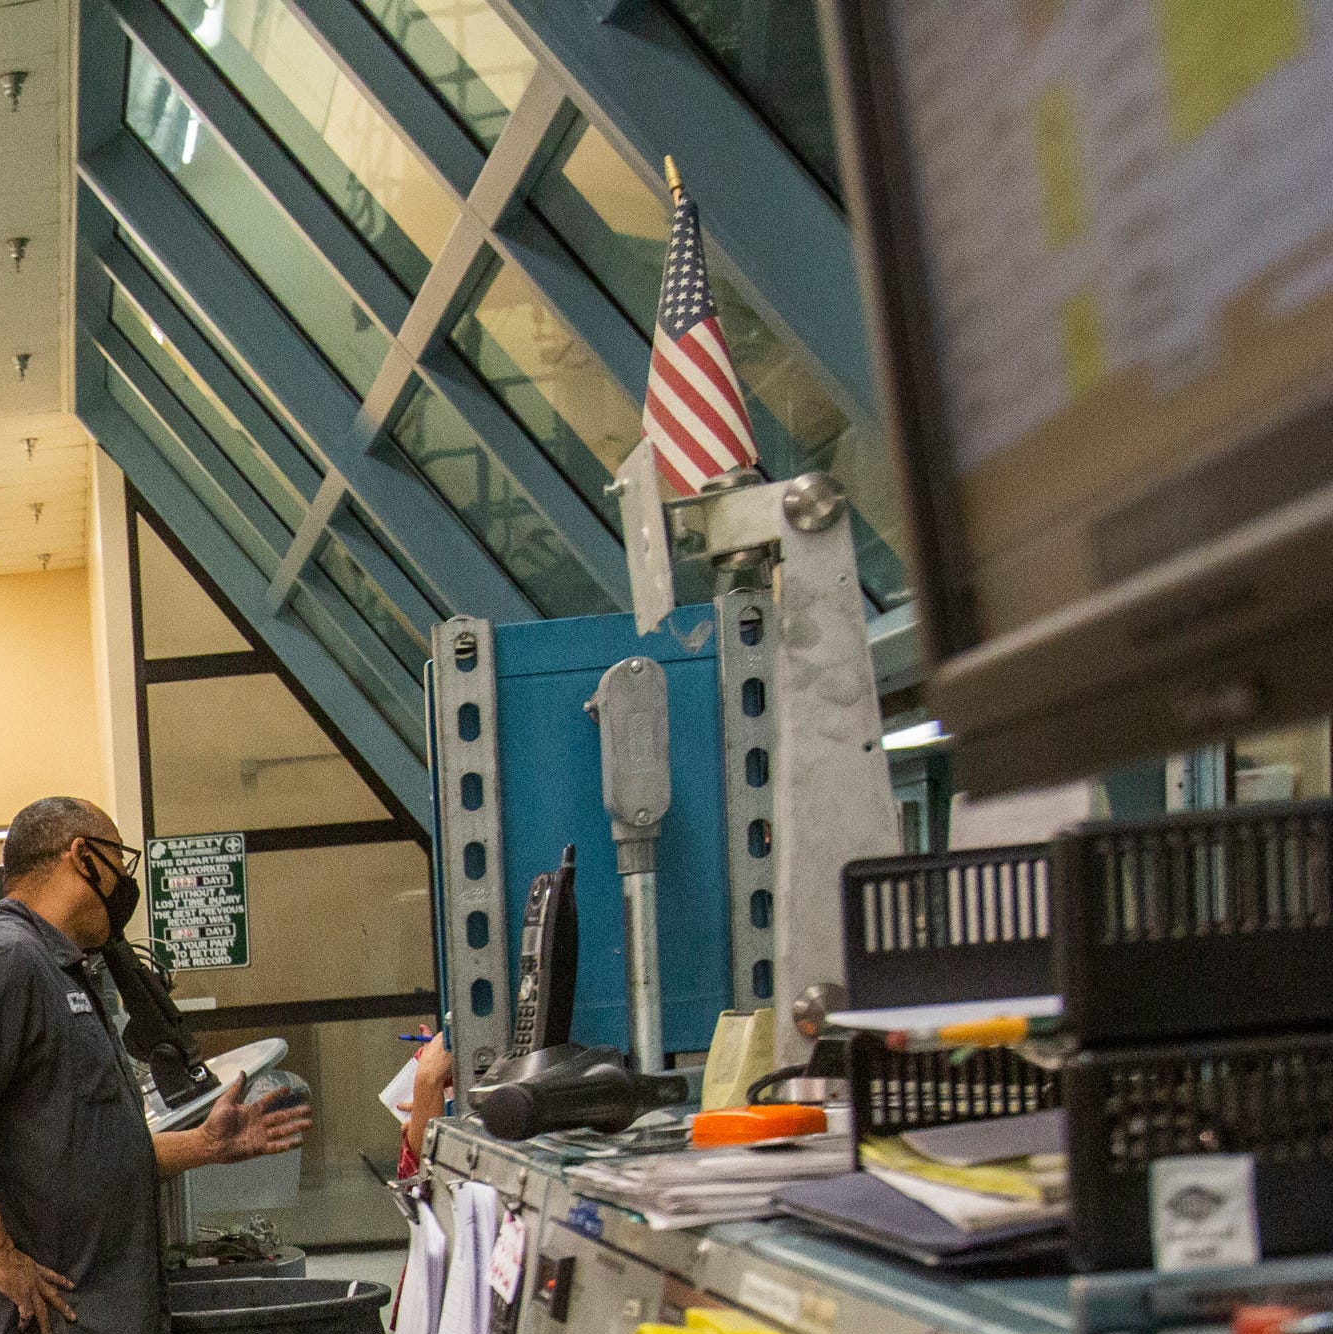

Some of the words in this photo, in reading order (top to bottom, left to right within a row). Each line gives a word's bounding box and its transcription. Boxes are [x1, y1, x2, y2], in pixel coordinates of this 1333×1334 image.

[167, 838, 224, 850] SAFETY
[150, 860, 174, 868] THIS
[176, 855, 243, 867] DEPARTMENT
[165, 867, 185, 876] HAS
[187, 864, 230, 875] WORKED
[202, 876, 228, 886] DAYS
[171, 889, 215, 900] WITHOUT
[218, 887, 226, 896] A
[155, 900, 180, 909] LOST
[183, 898, 206, 908] TIME
[208, 895, 241, 906] INJURY
[153, 911, 172, 920] THE
[173, 909, 196, 918] BEST
[199, 905, 244, 917] PREVIOUS
[167, 917, 207, 927] RECORD
[209, 915, 231, 924] WAS
[205, 926, 231, 936] DAYS
[166, 942, 180, 952] DO
[183, 940, 208, 950] YOUR
[209, 939, 235, 948] PART
[174, 950, 187, 959] TO
[189, 947, 228, 958] BETTER
[172, 958, 190, 968] THE
[192, 956, 233, 966] RECORD
